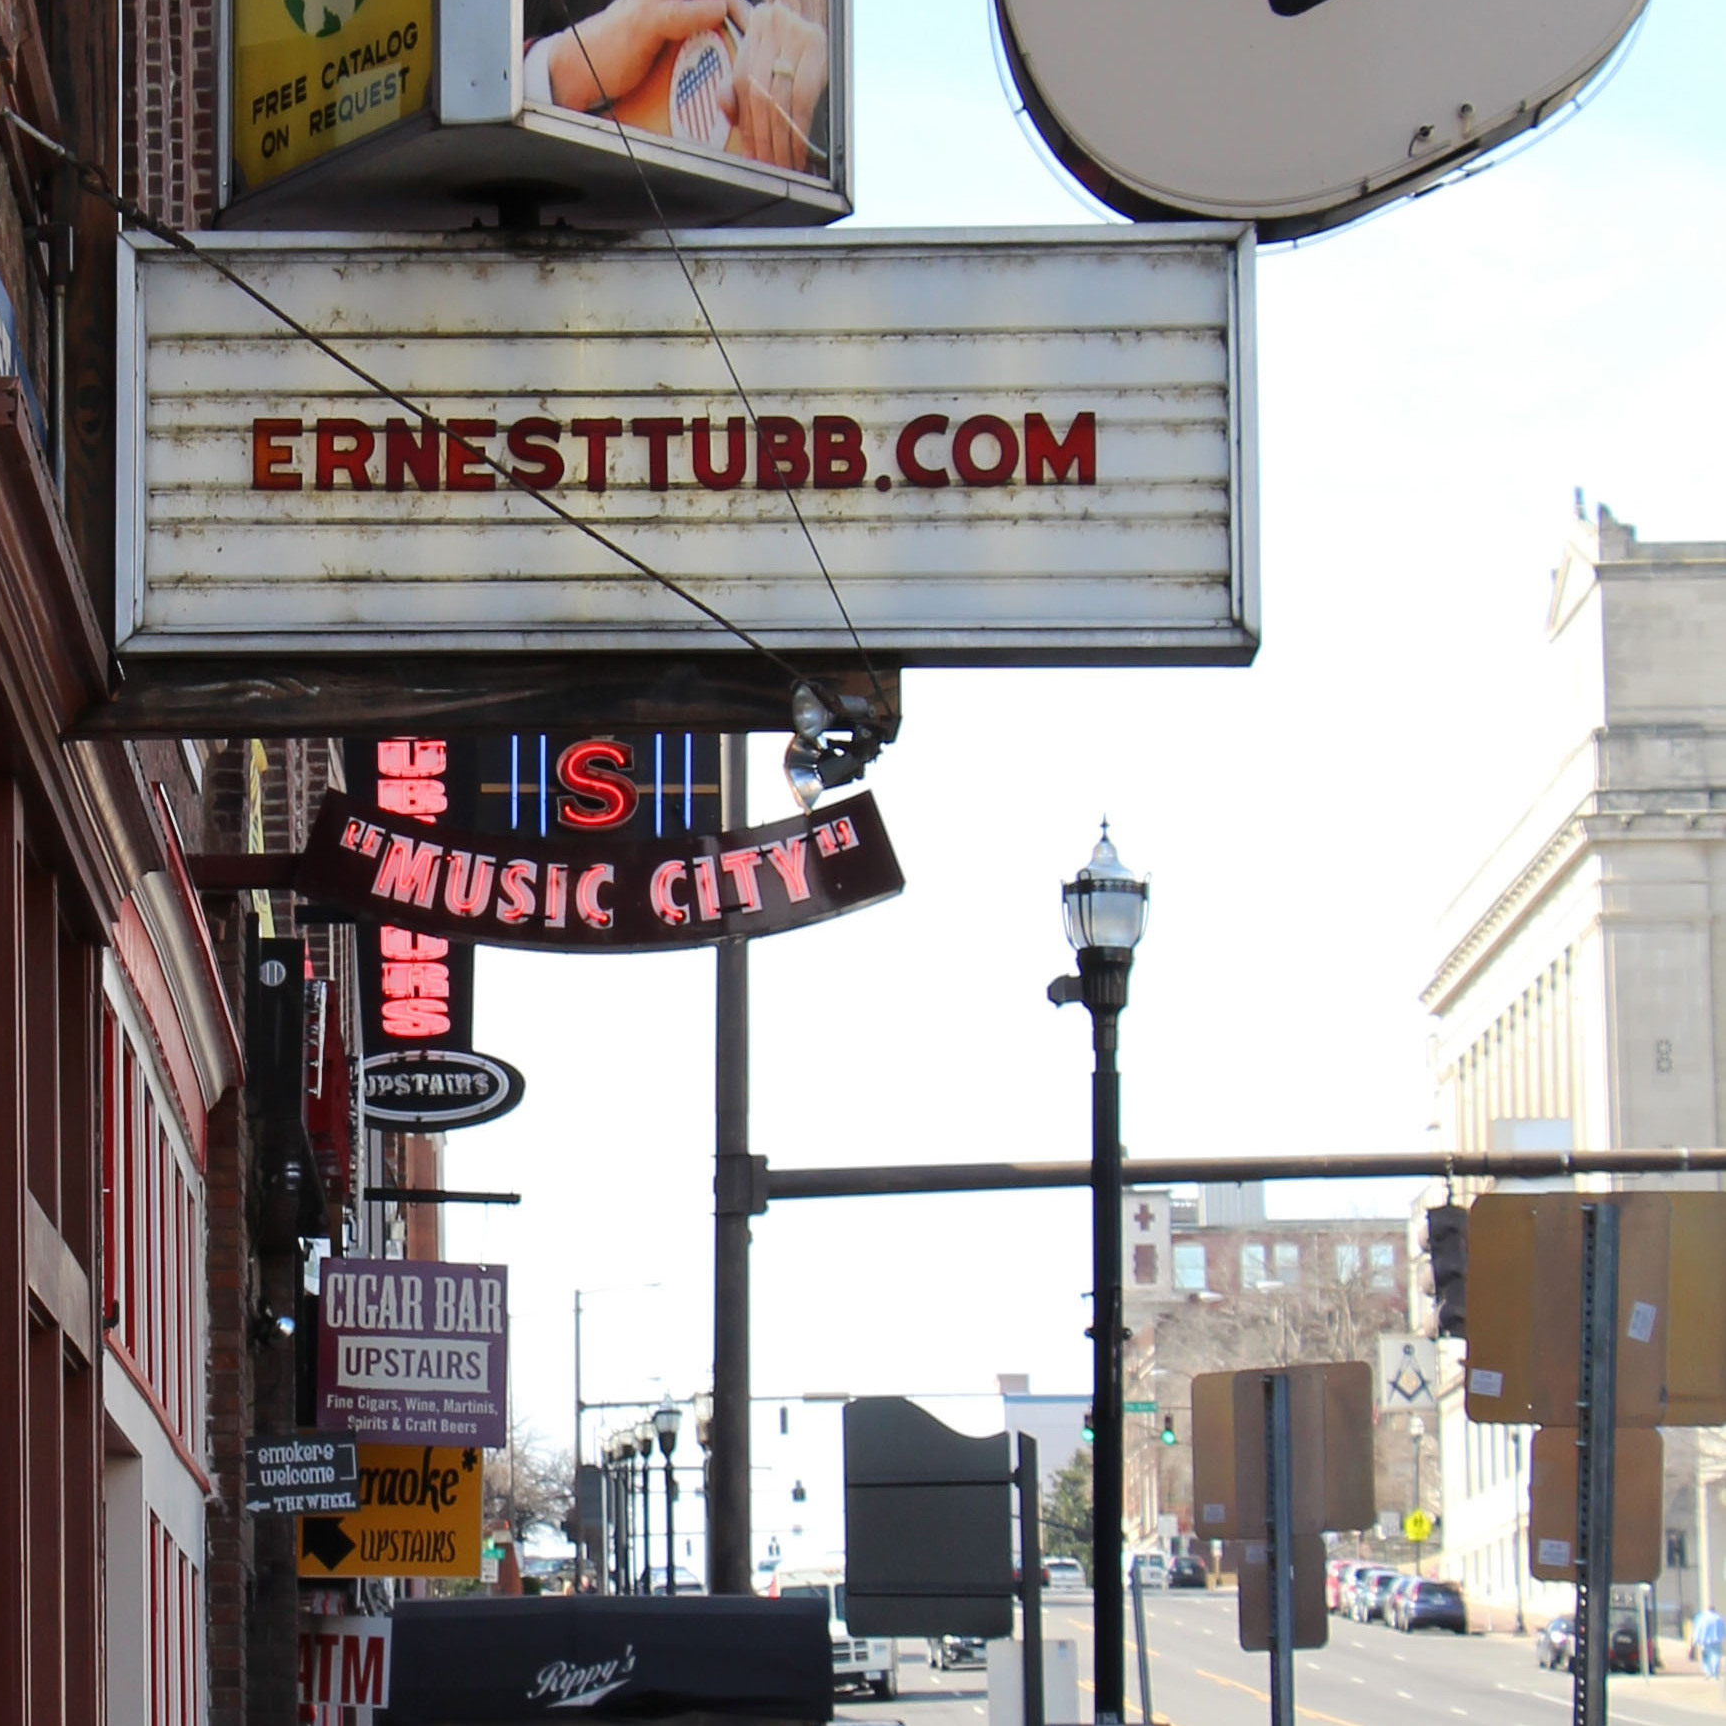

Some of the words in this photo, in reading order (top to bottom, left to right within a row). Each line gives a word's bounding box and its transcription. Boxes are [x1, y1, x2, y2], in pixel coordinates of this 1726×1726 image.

[252, 76, 307, 124] FREE
[321, 22, 418, 89] CATALOG
[261, 125, 290, 159] ON
[309, 67, 410, 136] REQUEST
[251, 411, 1097, 493] ERNESTTUBB.COM
[326, 1273, 423, 1331] CIGAR
[434, 1277, 503, 1335] BAR
[345, 1346, 482, 1380] UPSTAIRS
[326, 1394, 353, 1408] Fine
[358, 1395, 402, 1412] Cigars,
[405, 1397, 440, 1413] Wine,
[444, 1399, 499, 1416] Martinis,
[347, 1415, 388, 1432] Spirits
[392, 1417, 401, 1431] &
[405, 1417, 437, 1433] Craft
[441, 1420, 478, 1435] Beers
[258, 1441, 335, 1465] smokers
[260, 1464, 335, 1487] welcome
[274, 1495, 307, 1513] THE
[307, 1492, 356, 1510] WHEEL
[360, 1530, 456, 1564] UPSTAIRS
[527, 1644, 636, 1699] Rippy's
